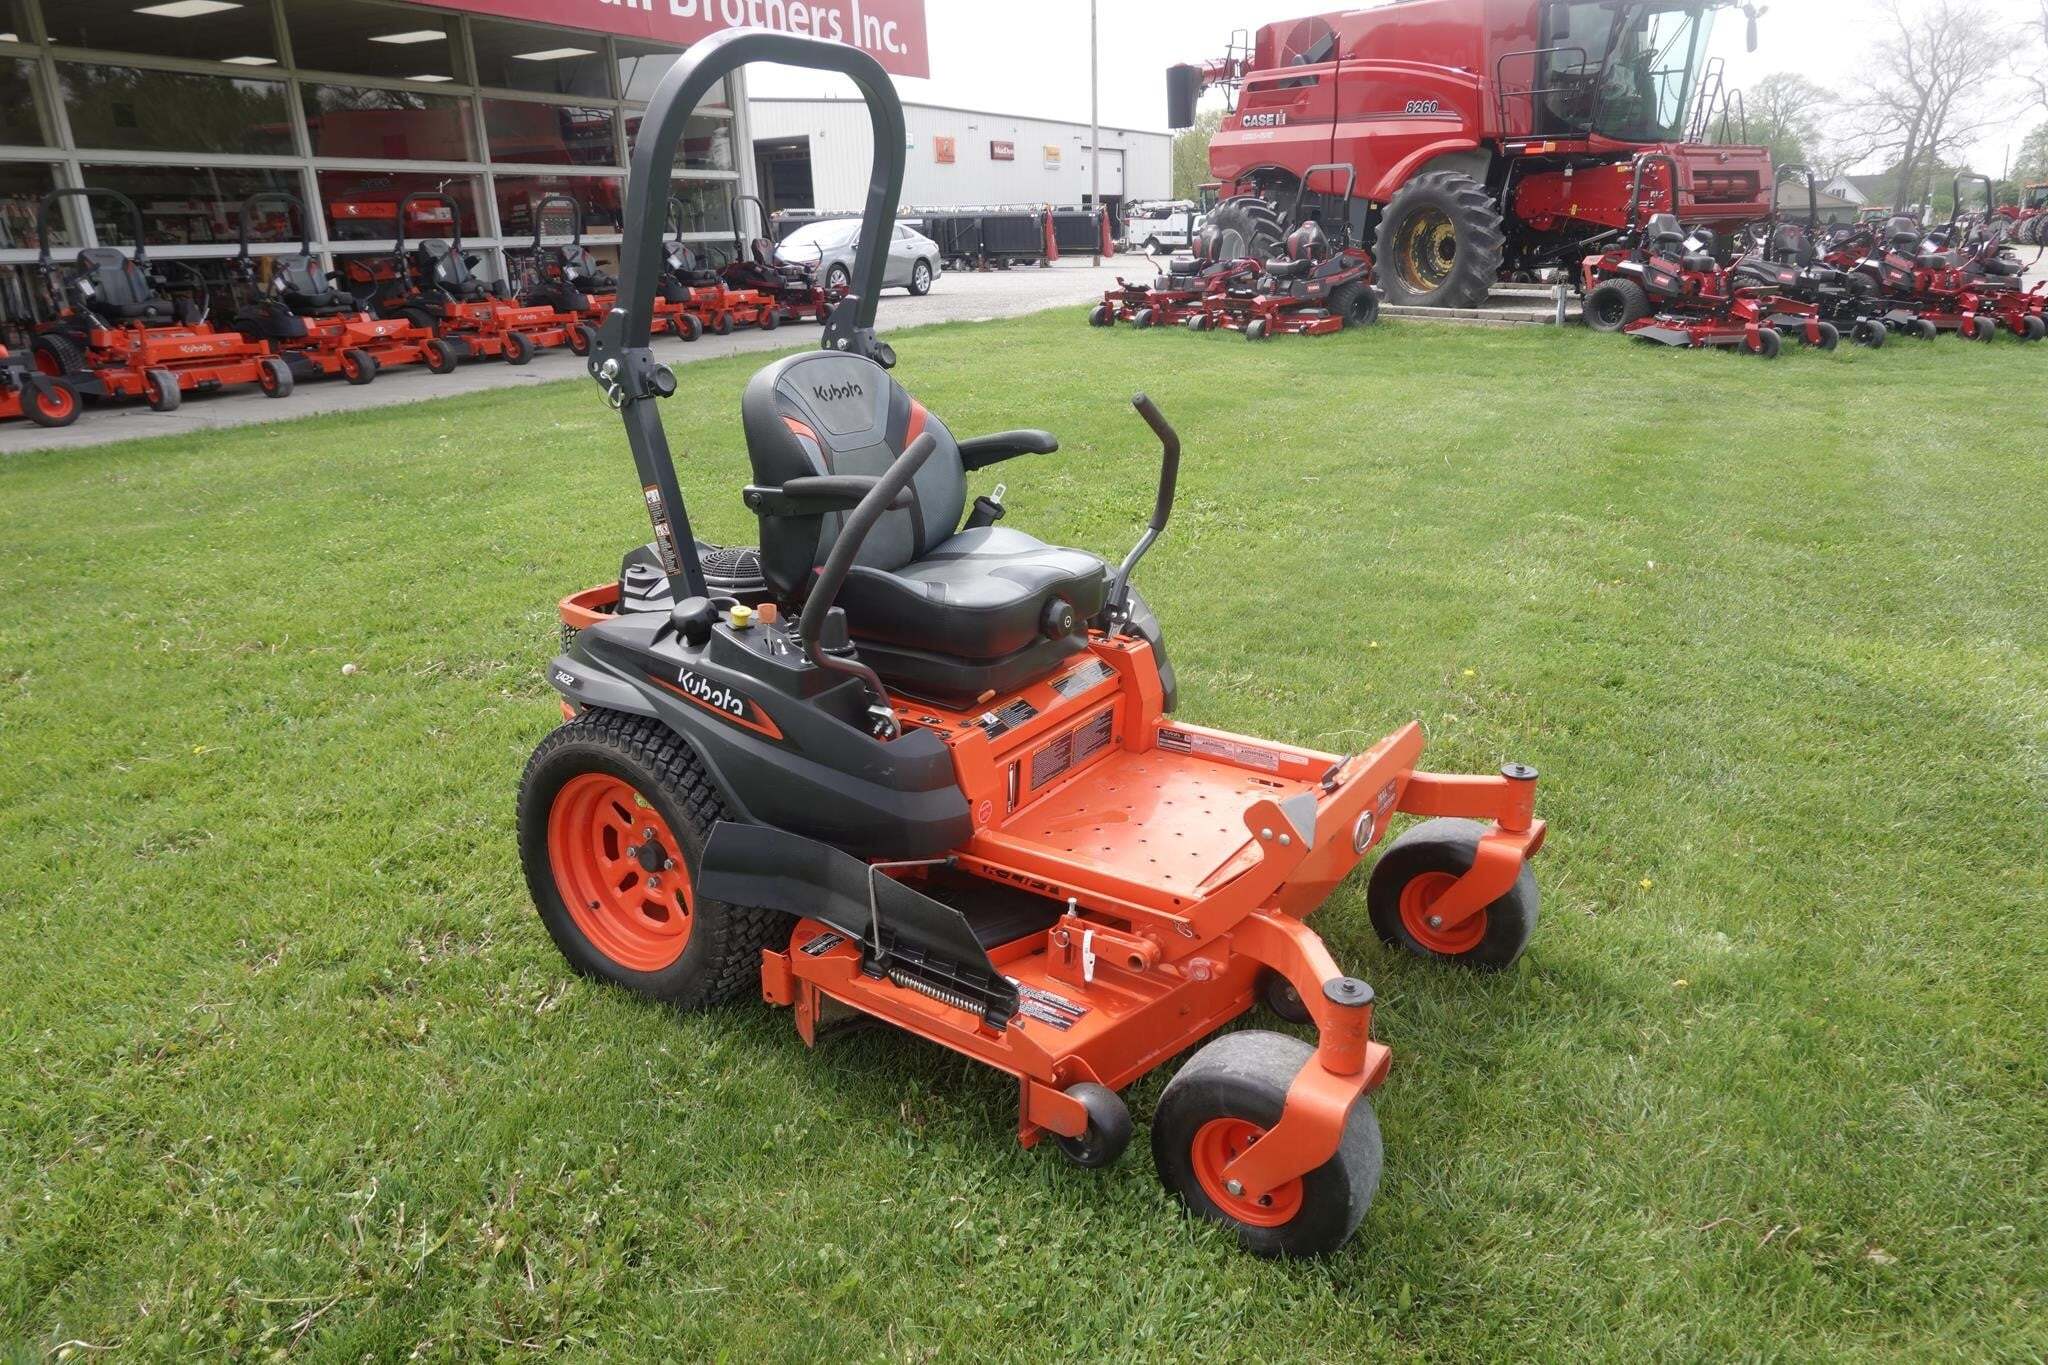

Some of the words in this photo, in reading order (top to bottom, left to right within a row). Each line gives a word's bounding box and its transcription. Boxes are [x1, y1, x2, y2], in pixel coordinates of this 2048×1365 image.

[849, 0, 907, 54] Inc.
[1405, 100, 1438, 114] 8260
[1243, 113, 1274, 128] CASE
[812, 380, 864, 402] Kubota
[555, 670, 576, 686] Z422
[678, 667, 744, 717] Kubota
